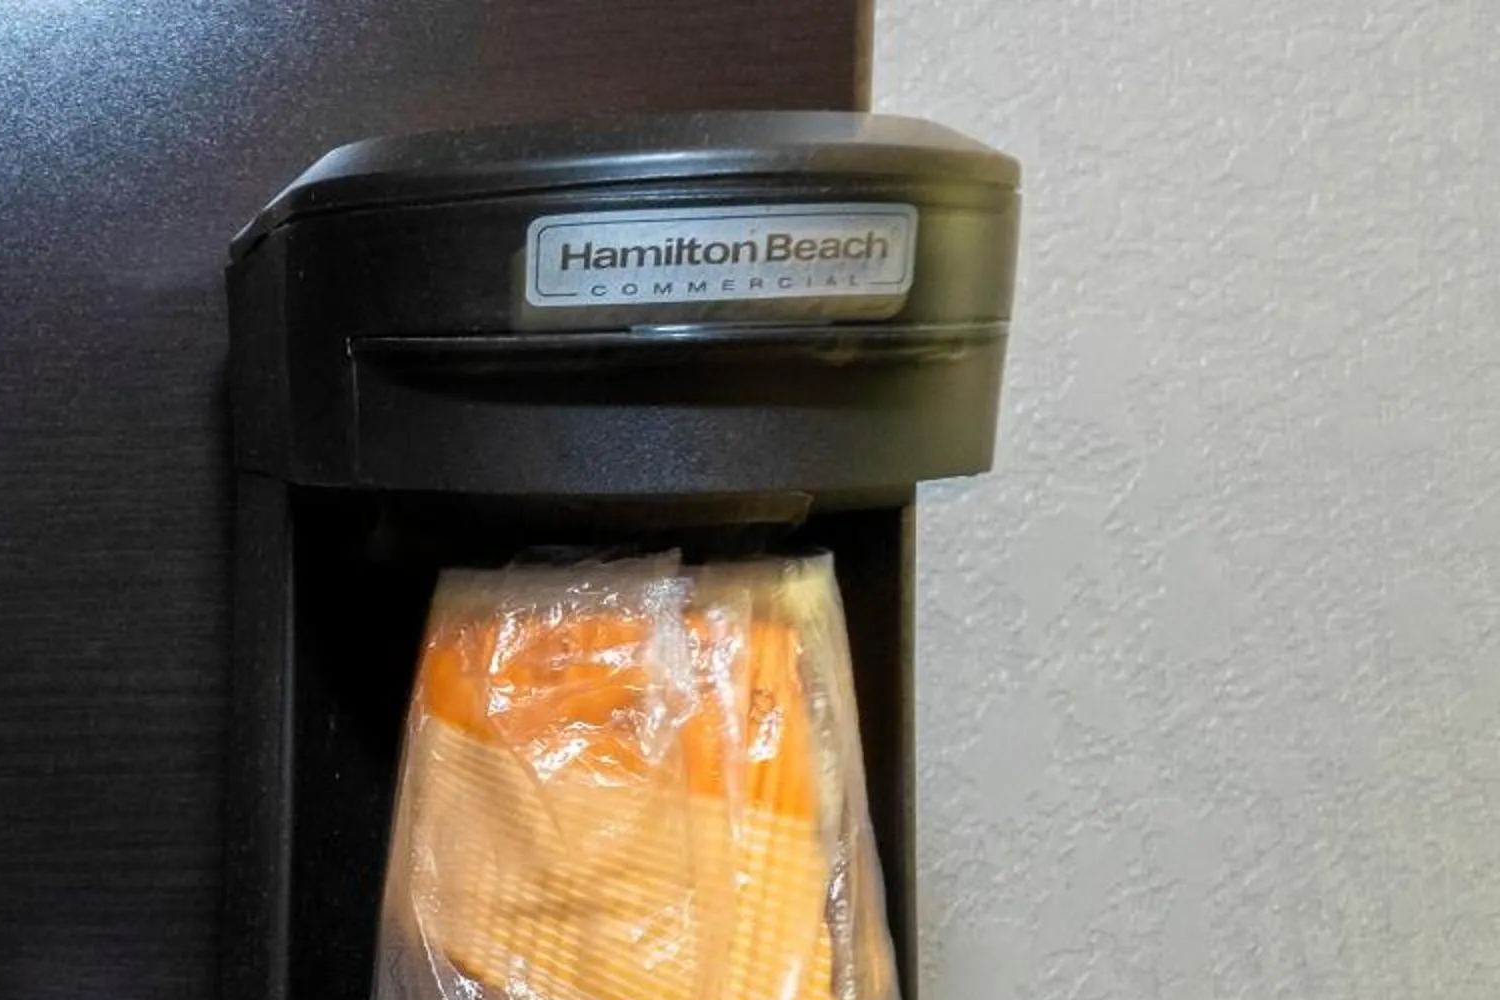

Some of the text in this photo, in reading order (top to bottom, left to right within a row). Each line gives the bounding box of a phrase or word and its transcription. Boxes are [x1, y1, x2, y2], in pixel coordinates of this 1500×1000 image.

[560, 231, 889, 271] Hamilton Beach
[590, 275, 860, 298] COMMERCIAL
